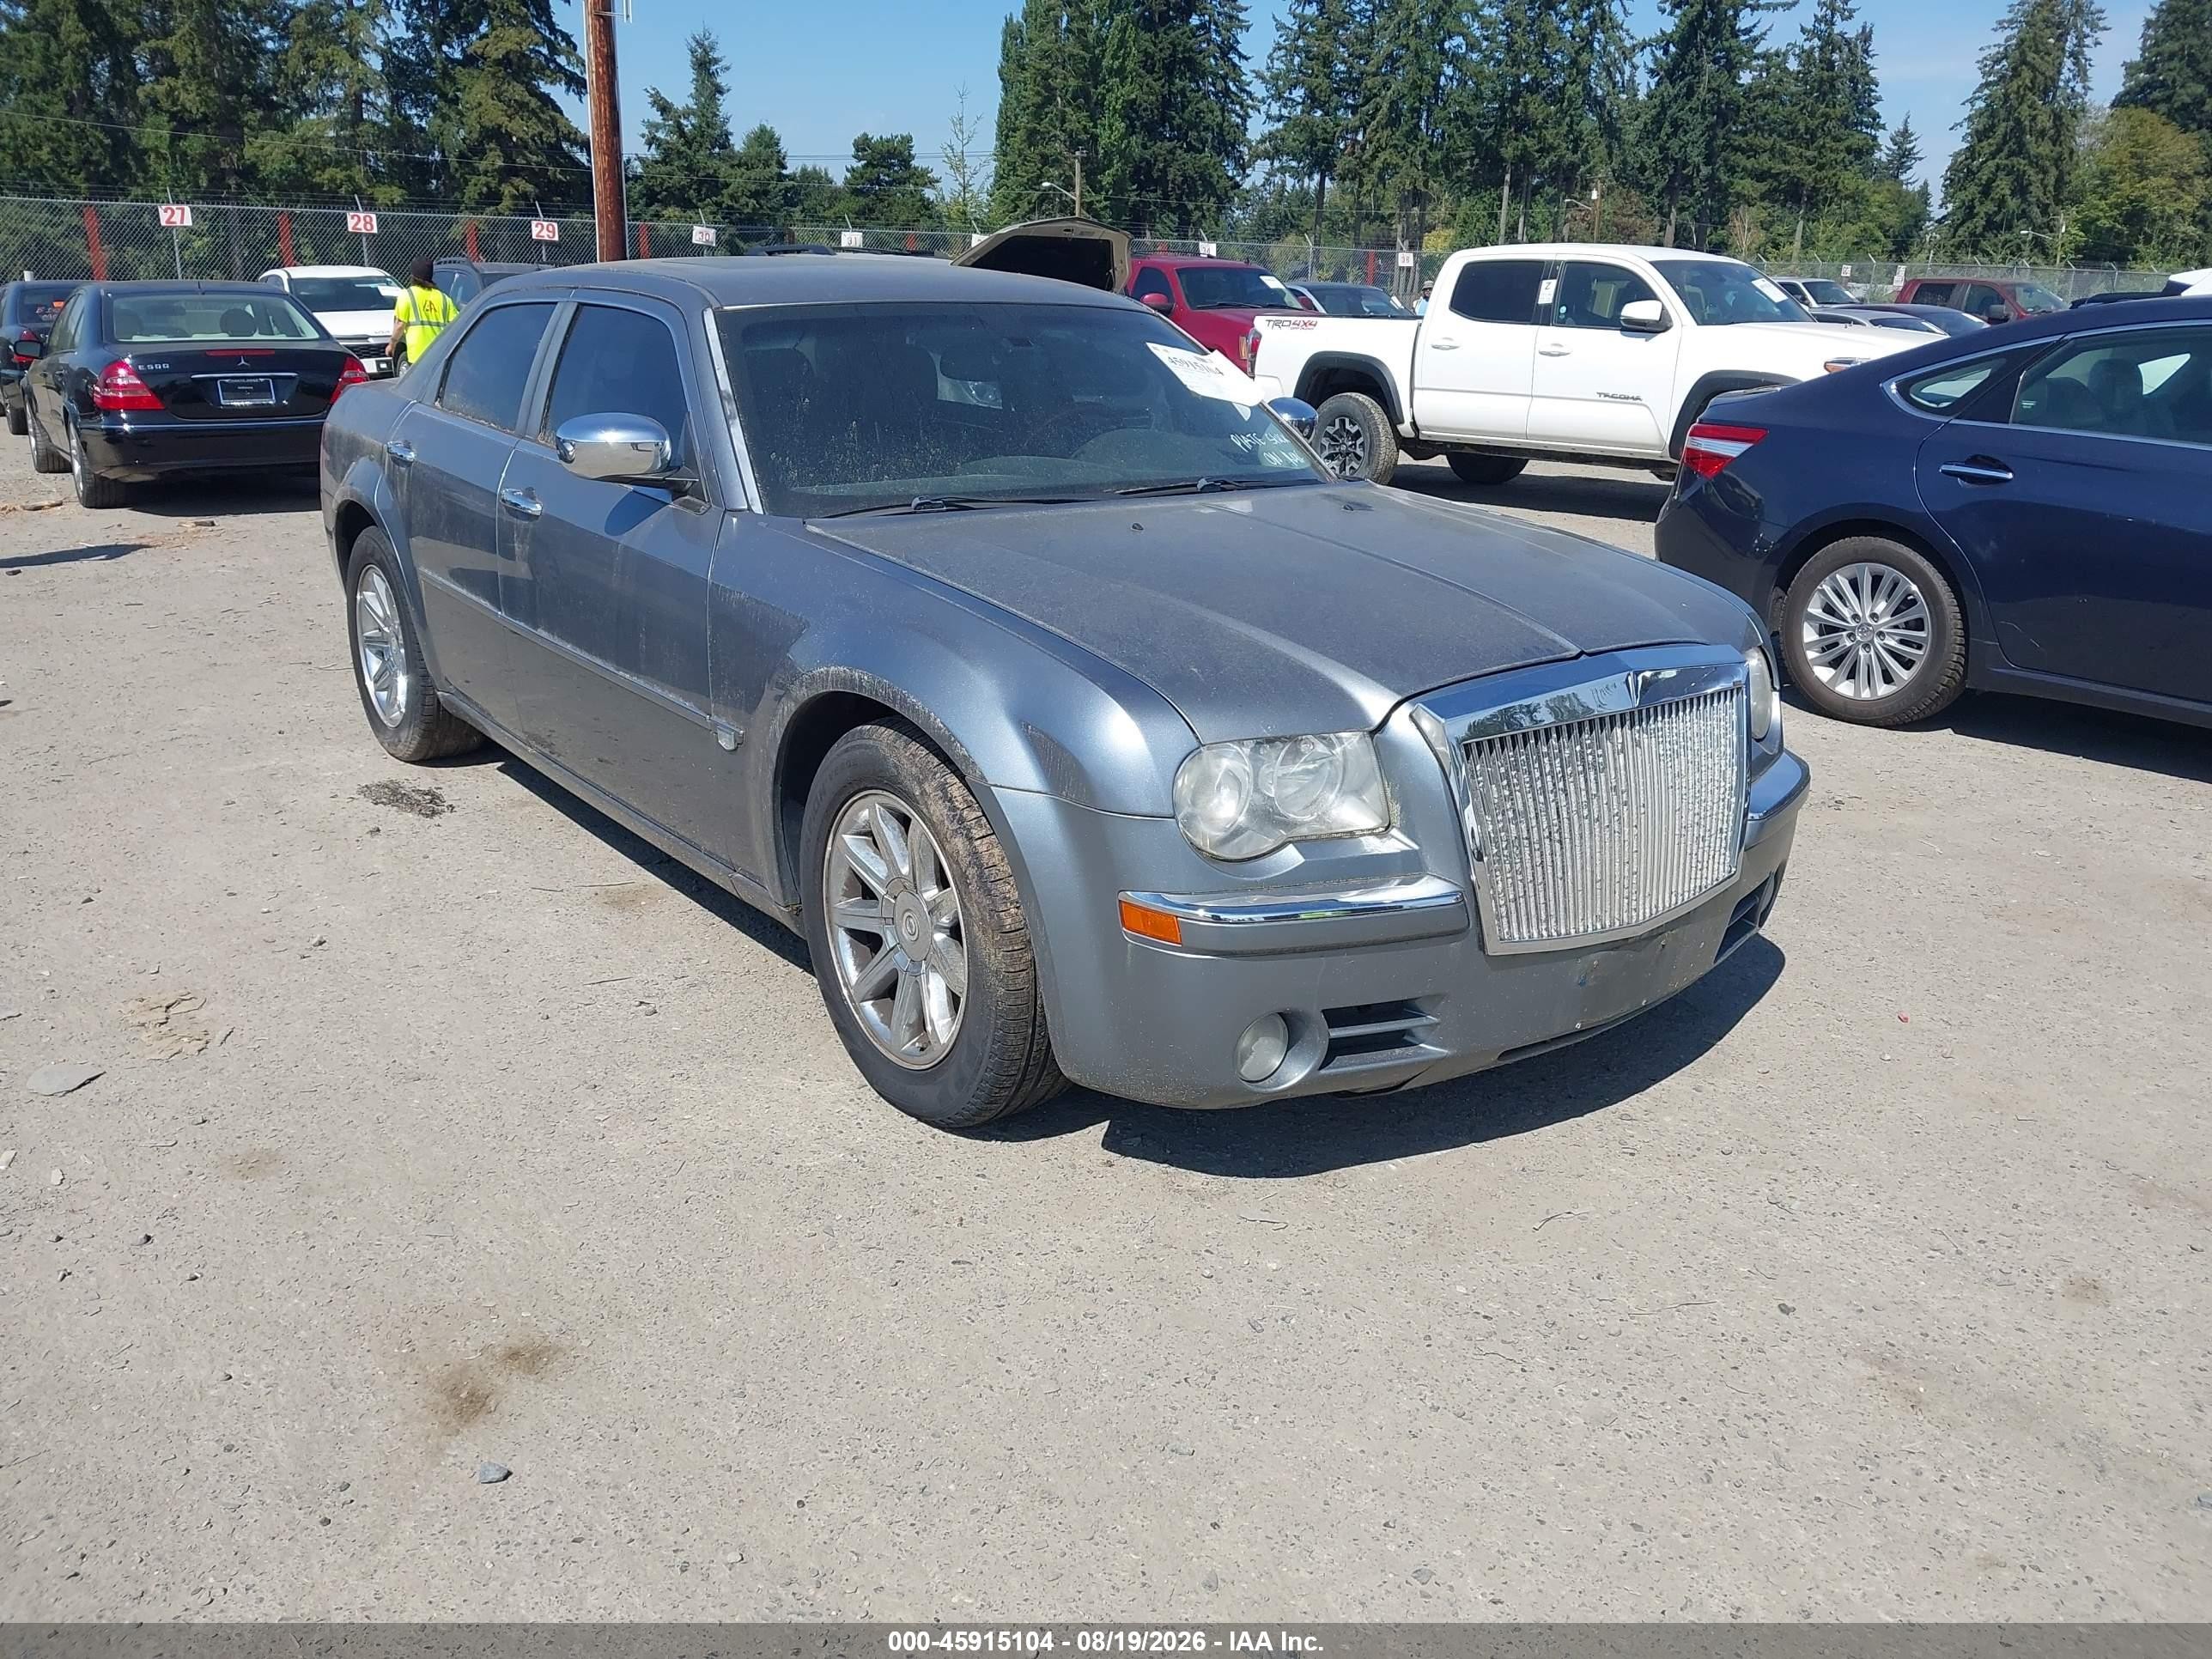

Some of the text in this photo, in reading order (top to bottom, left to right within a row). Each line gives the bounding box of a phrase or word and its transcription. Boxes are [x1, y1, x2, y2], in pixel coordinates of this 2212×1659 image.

[163, 206, 185, 224] 27
[350, 214, 374, 231] 28
[535, 222, 556, 239] 29
[698, 232, 710, 241] 30
[848, 236, 857, 246] 31
[1596, 392, 1643, 402] TACOMA
